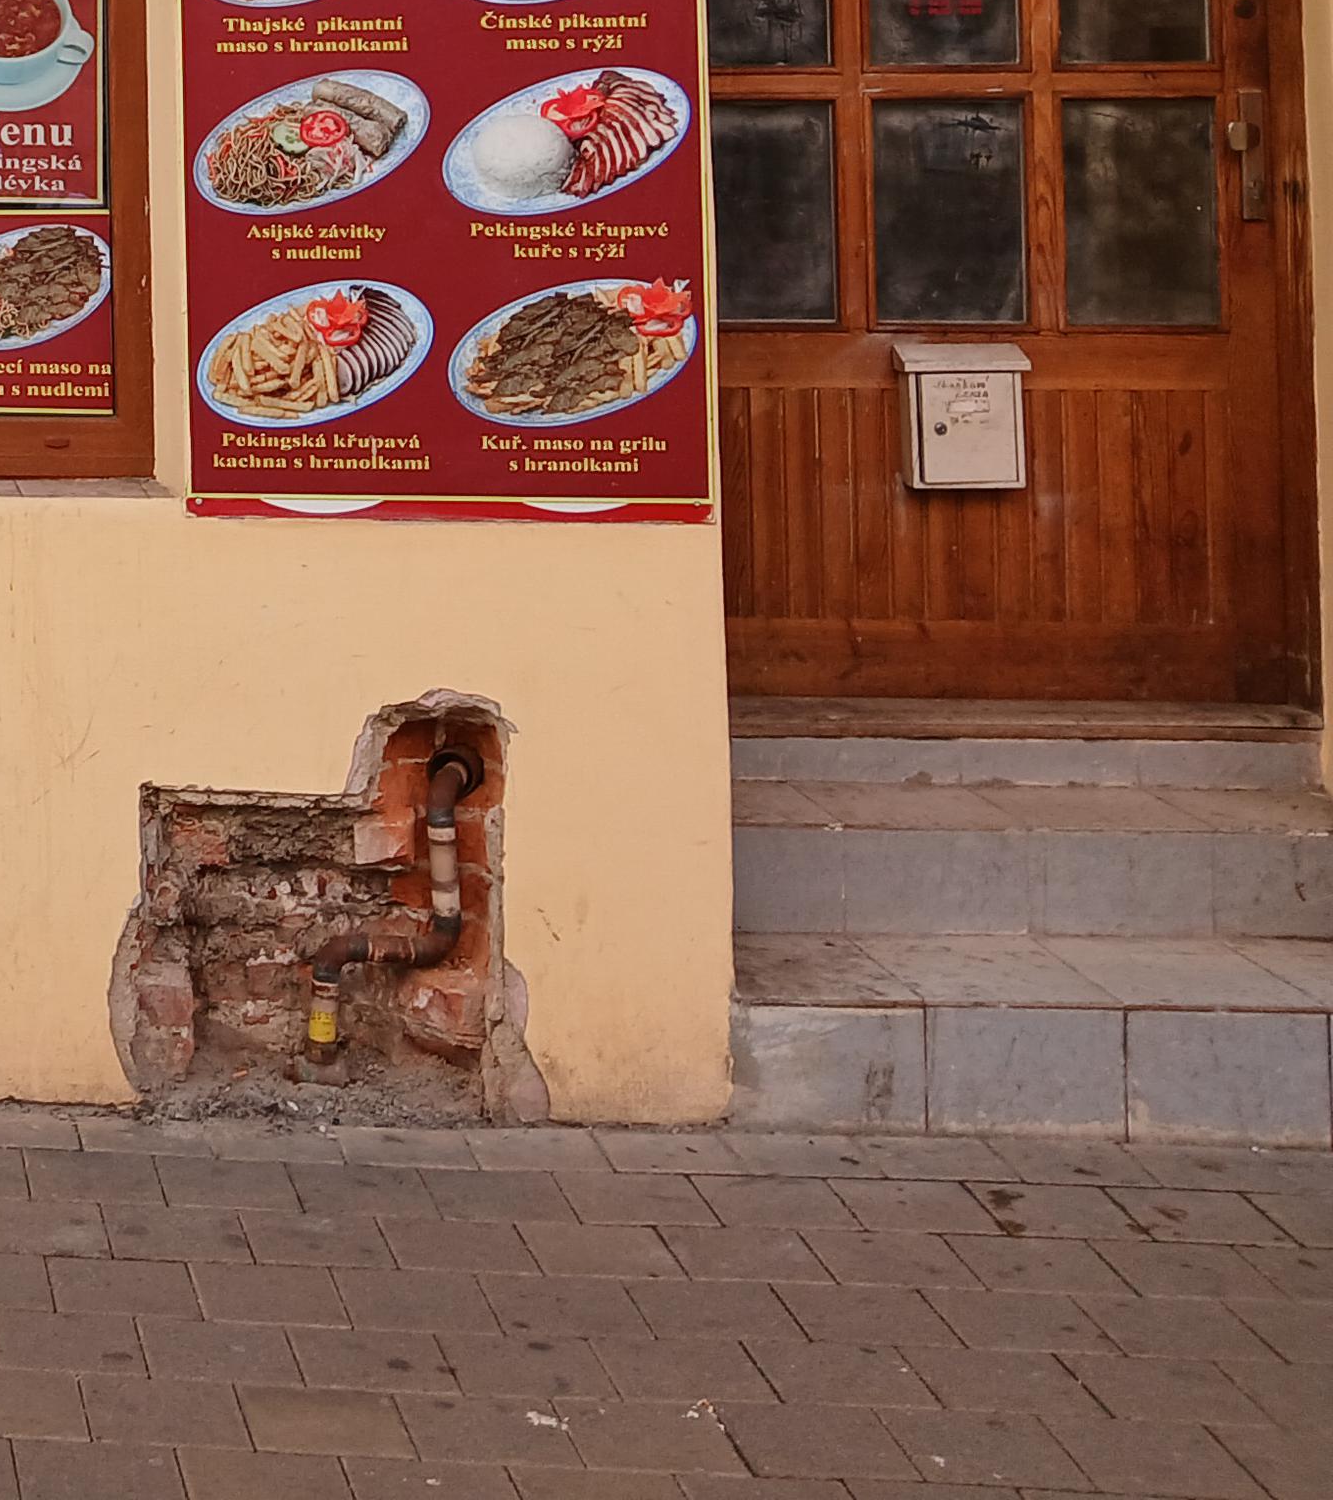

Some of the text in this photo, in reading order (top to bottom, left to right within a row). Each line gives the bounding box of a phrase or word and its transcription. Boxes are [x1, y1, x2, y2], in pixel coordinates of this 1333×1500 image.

[222, 16, 403, 35] Thajské pikantní
[480, 10, 647, 32] Čínské pikantní
[216, 36, 408, 53] maso s hranolkami
[506, 34, 623, 53] maso s rýží
[246, 224, 386, 242] Asijské závitky
[470, 222, 669, 241] Pekingské křupavé
[271, 244, 361, 260] s nudlemi
[514, 243, 625, 262] kuře s rýží
[29, 363, 82, 375] maso
[88, 363, 112, 375] na
[11, 385, 21, 396] s
[27, 381, 110, 397] nudlemi
[222, 432, 422, 452] Pekingská křupavá
[481, 435, 667, 455] Kuř. maso na grilu
[213, 453, 431, 471] kachna s hranolkami
[509, 457, 639, 473] s hranolkami
